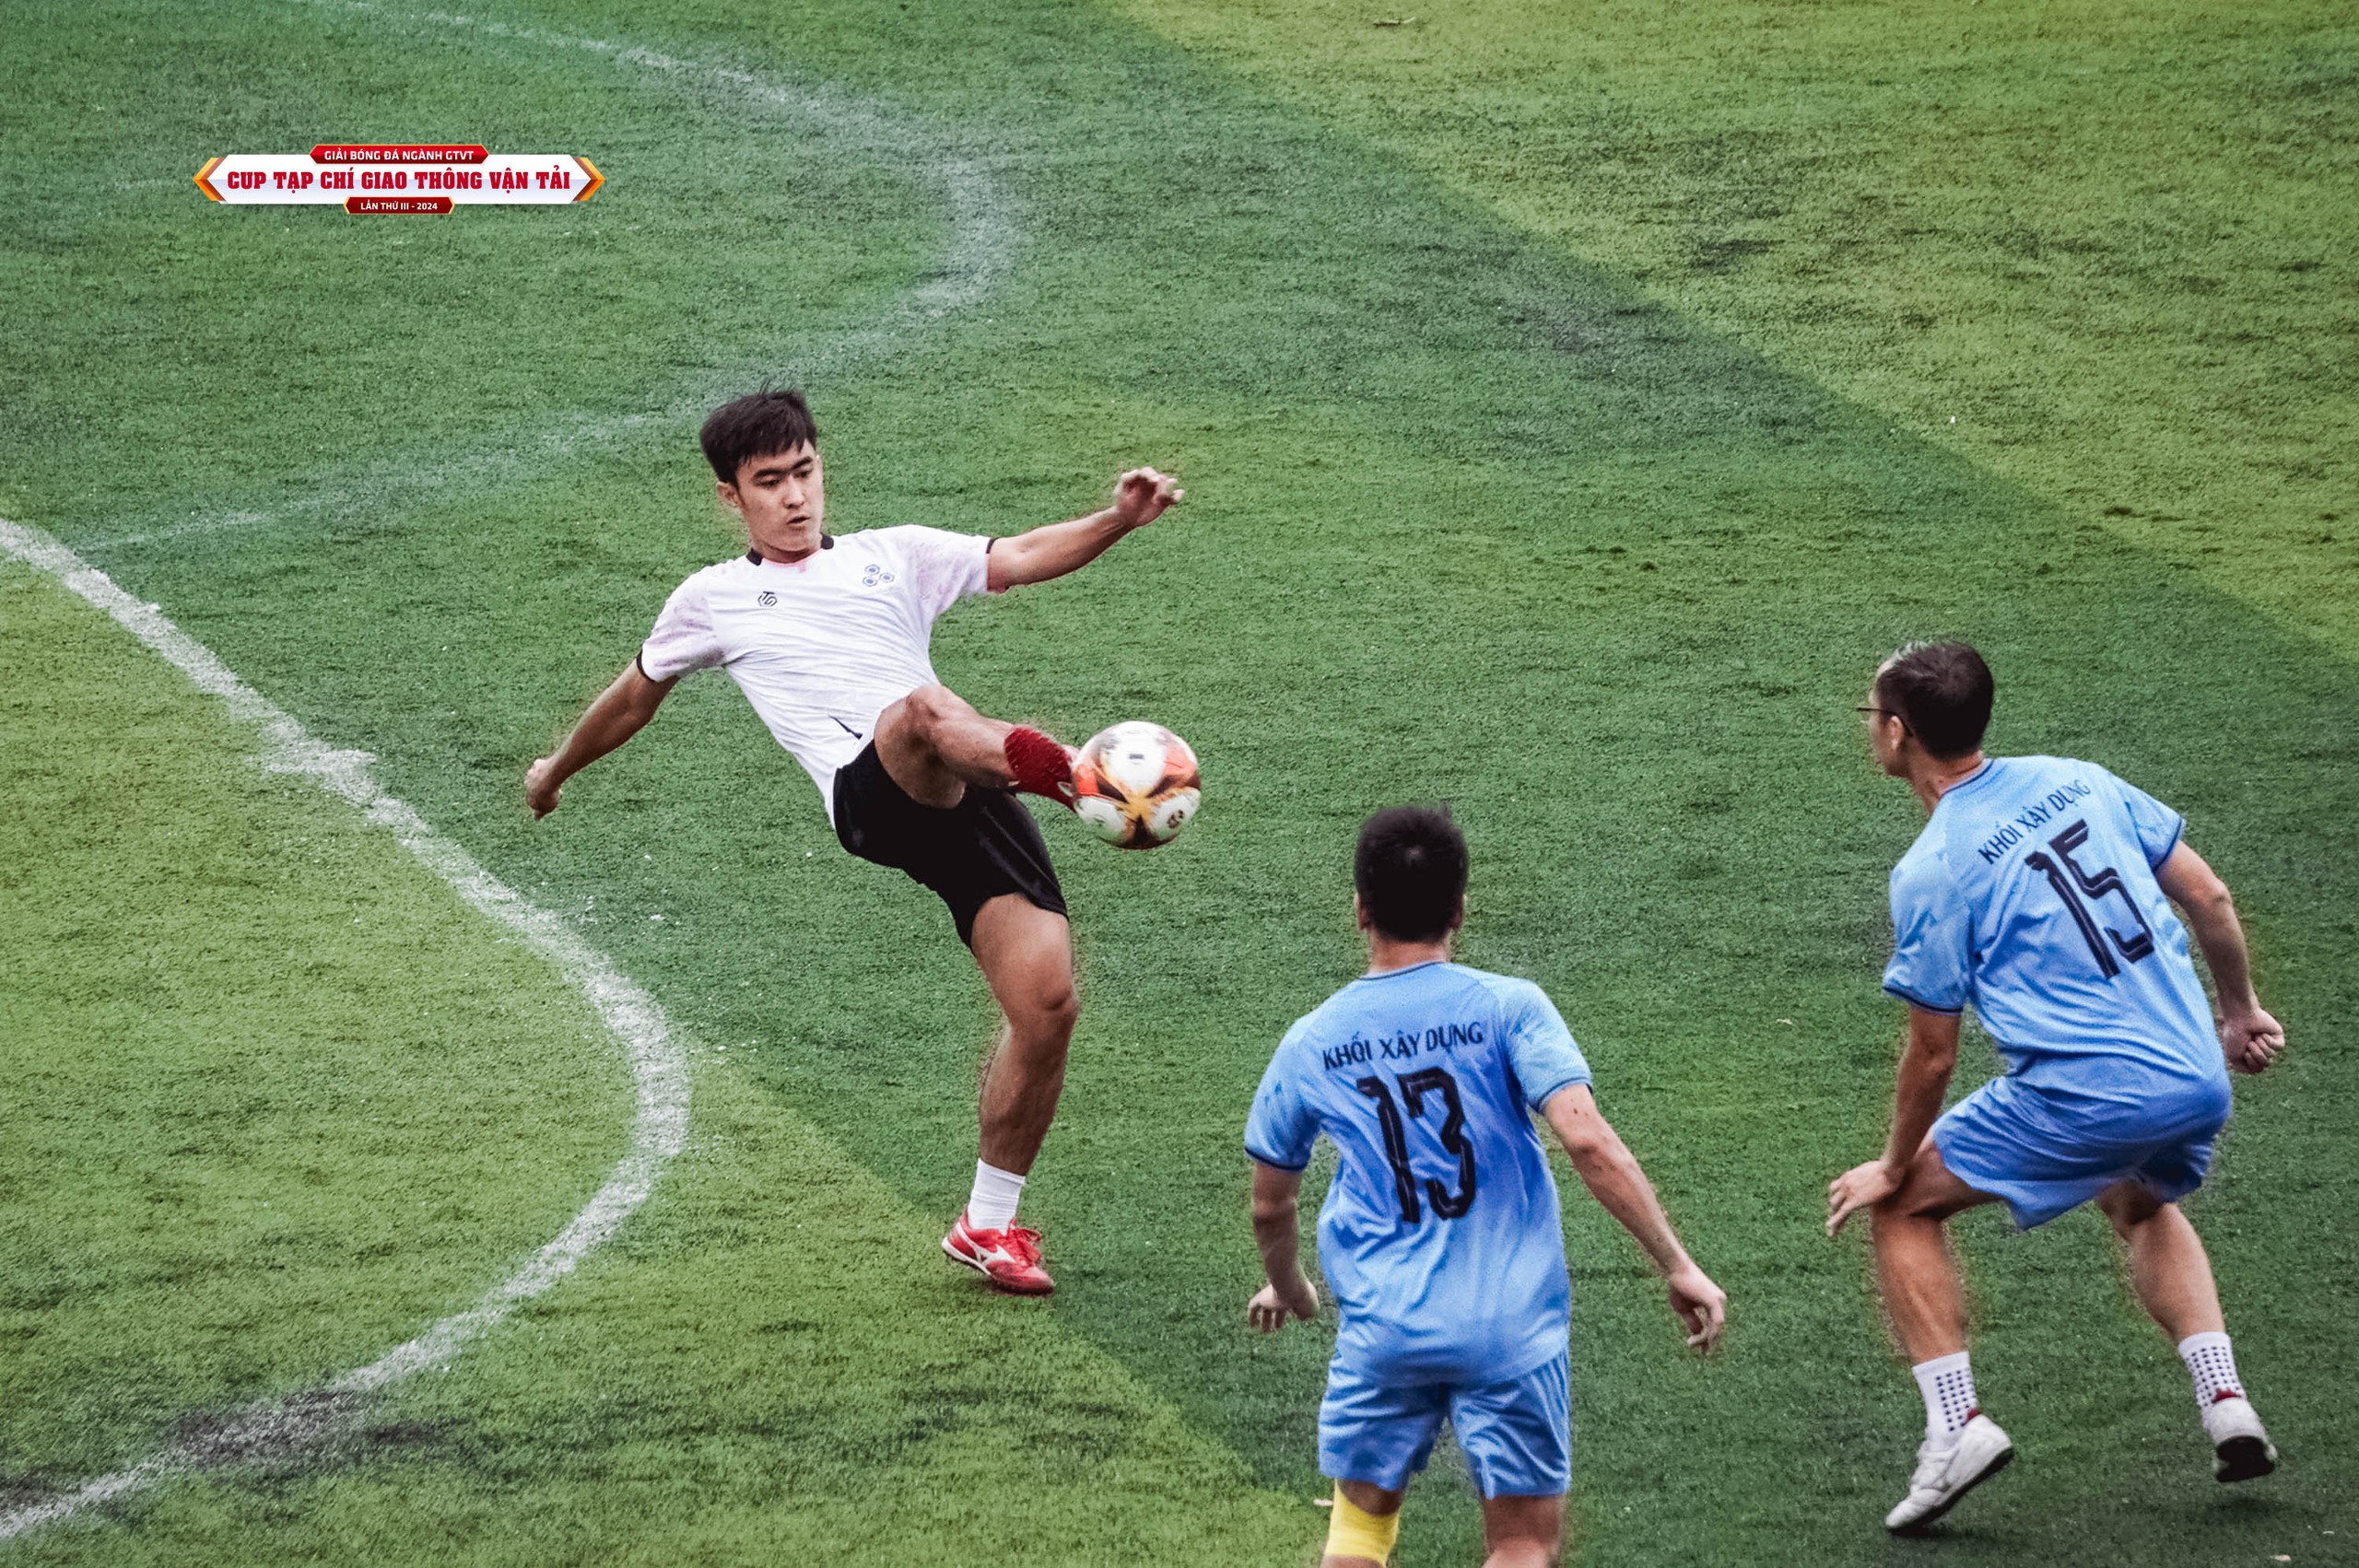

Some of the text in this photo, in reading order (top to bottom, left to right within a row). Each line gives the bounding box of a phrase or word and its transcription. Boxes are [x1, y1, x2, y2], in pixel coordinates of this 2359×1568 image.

[2024, 818, 2155, 980] 15
[1322, 1031, 1372, 1071] KHỐI
[1379, 1029, 1421, 1060] XÂY
[1356, 1066, 1476, 1224] 13
